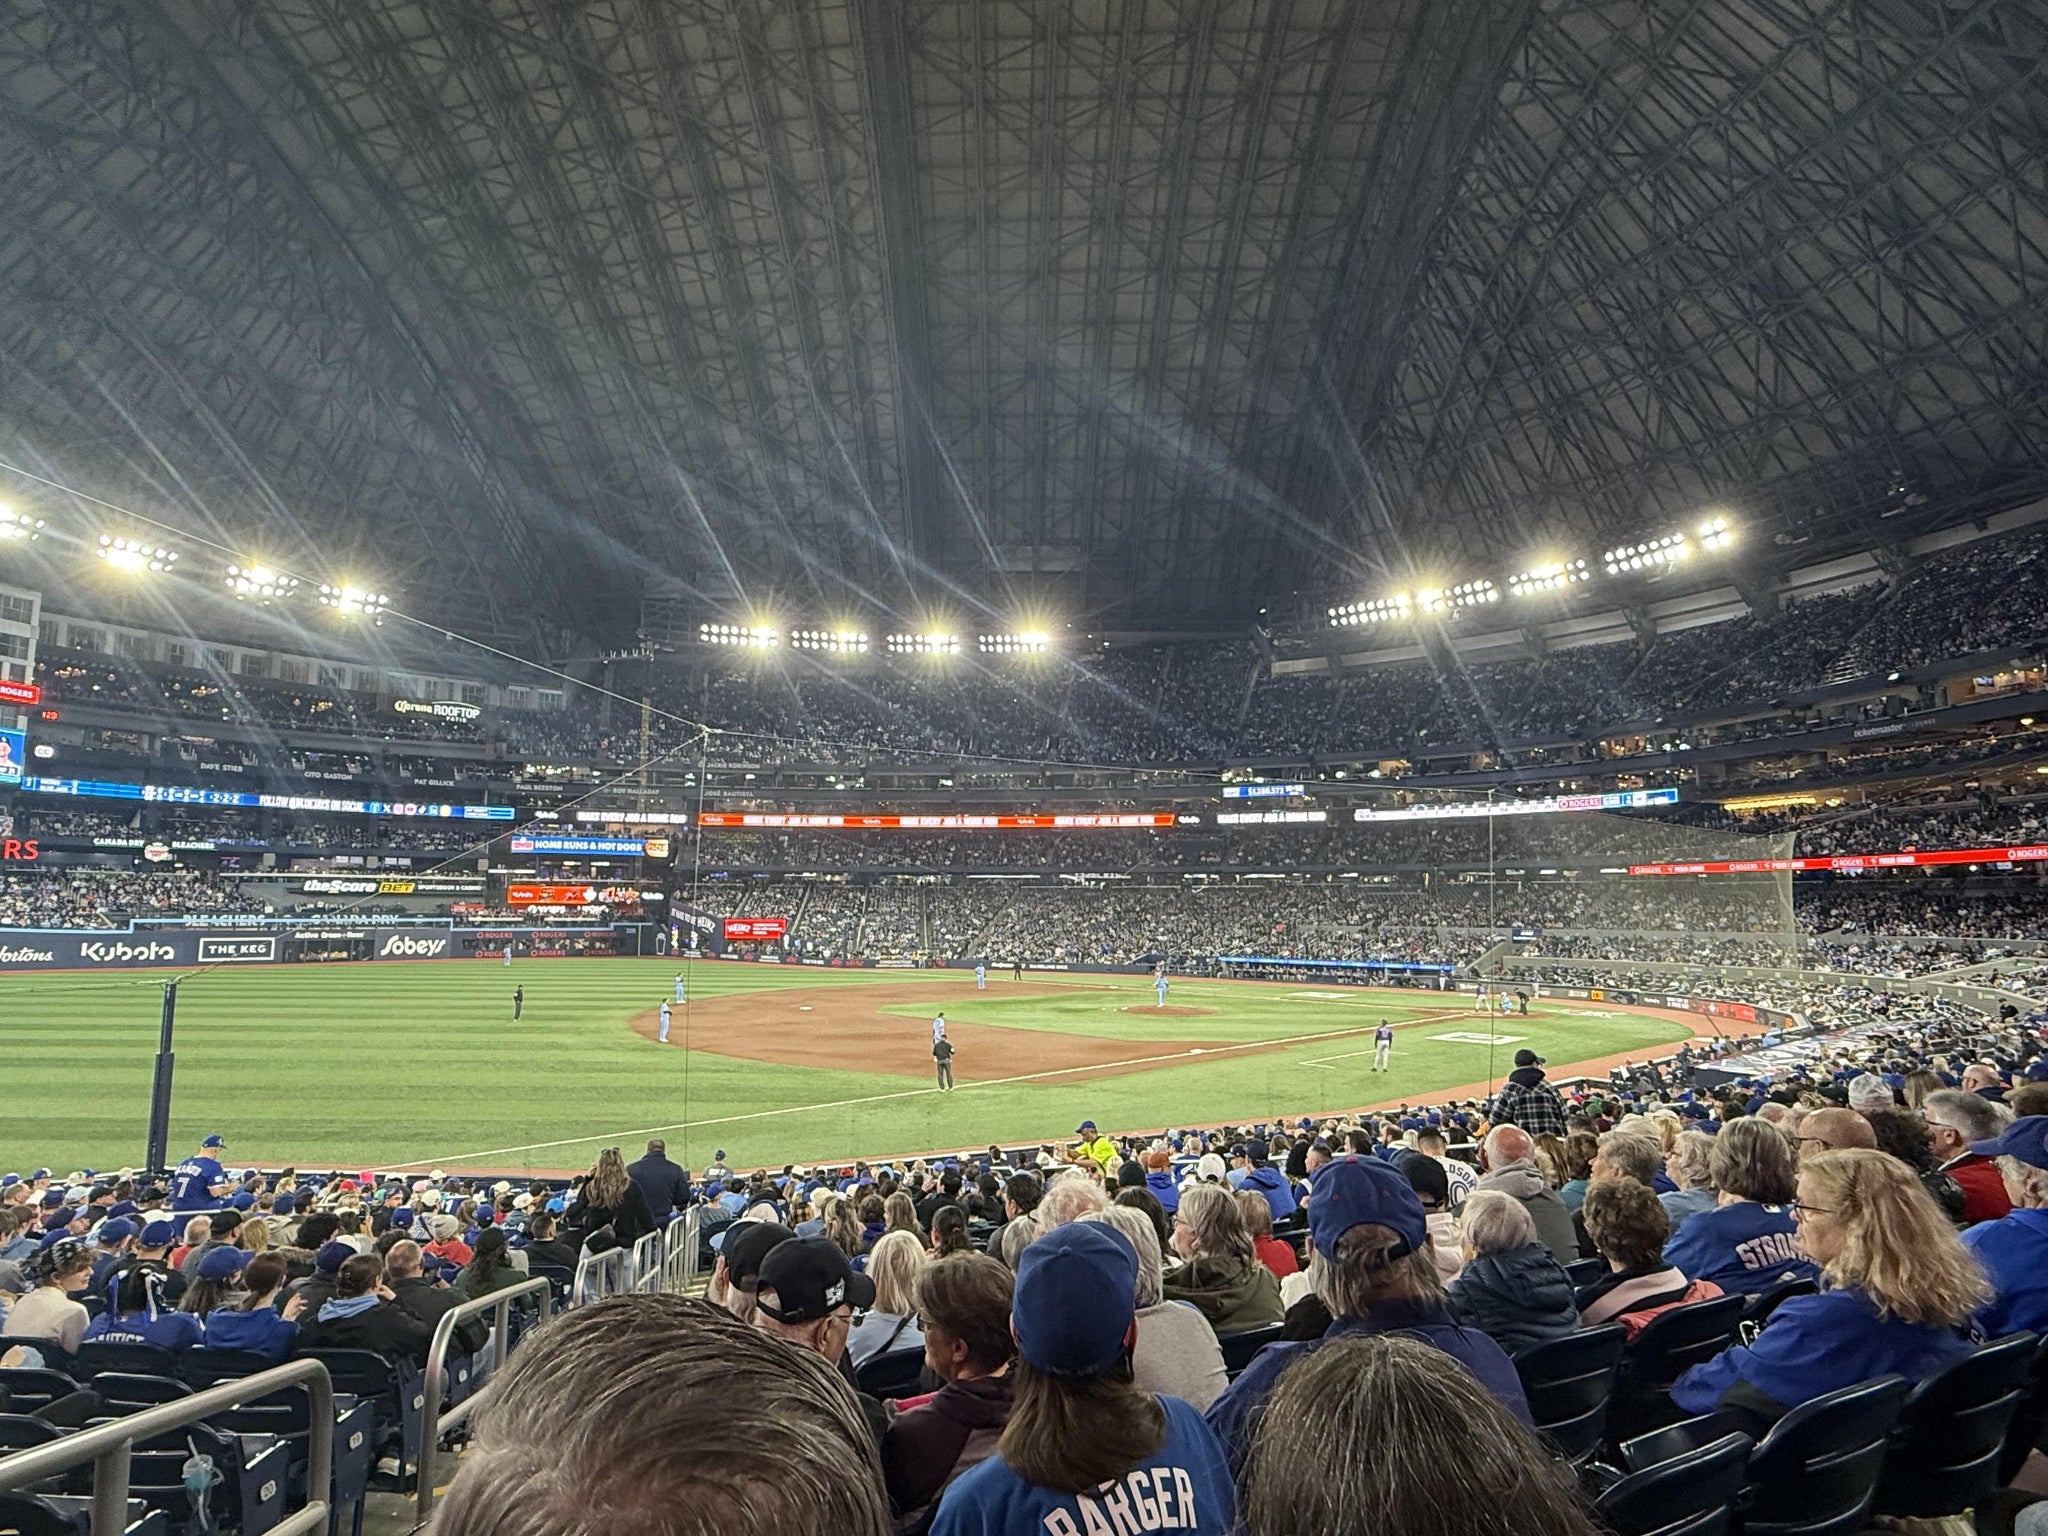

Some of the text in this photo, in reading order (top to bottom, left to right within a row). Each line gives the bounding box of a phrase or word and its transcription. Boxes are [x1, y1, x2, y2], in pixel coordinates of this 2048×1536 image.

[0, 686, 33, 698] ROGERS
[394, 700, 432, 713] Corona
[433, 705, 480, 719] ROOFTOP
[1854, 724, 1902, 737] ticketmaster
[223, 764, 243, 772] STIEB
[428, 779, 455, 787] GILLICK
[1569, 798, 1599, 808] ROGERS
[93, 838, 145, 848] CANADA DRY
[172, 841, 215, 849] BLEACHERS
[535, 840, 562, 849] HOME
[563, 841, 588, 850] RUNS
[589, 841, 597, 850] &
[598, 841, 616, 850] HOT
[617, 842, 642, 851] DOGS
[2016, 849, 2048, 857] ROGERS
[303, 880, 413, 892] theScore BET
[697, 916, 716, 933] HEINZ
[727, 923, 751, 933] HEINZ
[80, 942, 175, 961] Kubota
[208, 945, 267, 954] THE KEG
[380, 935, 447, 957] Sobeys
[1448, 1164, 1476, 1188] DSON
[177, 1177, 190, 1198] 7
[263, 1483, 273, 1498] 20
[1043, 1467, 1198, 1536] BARGER
